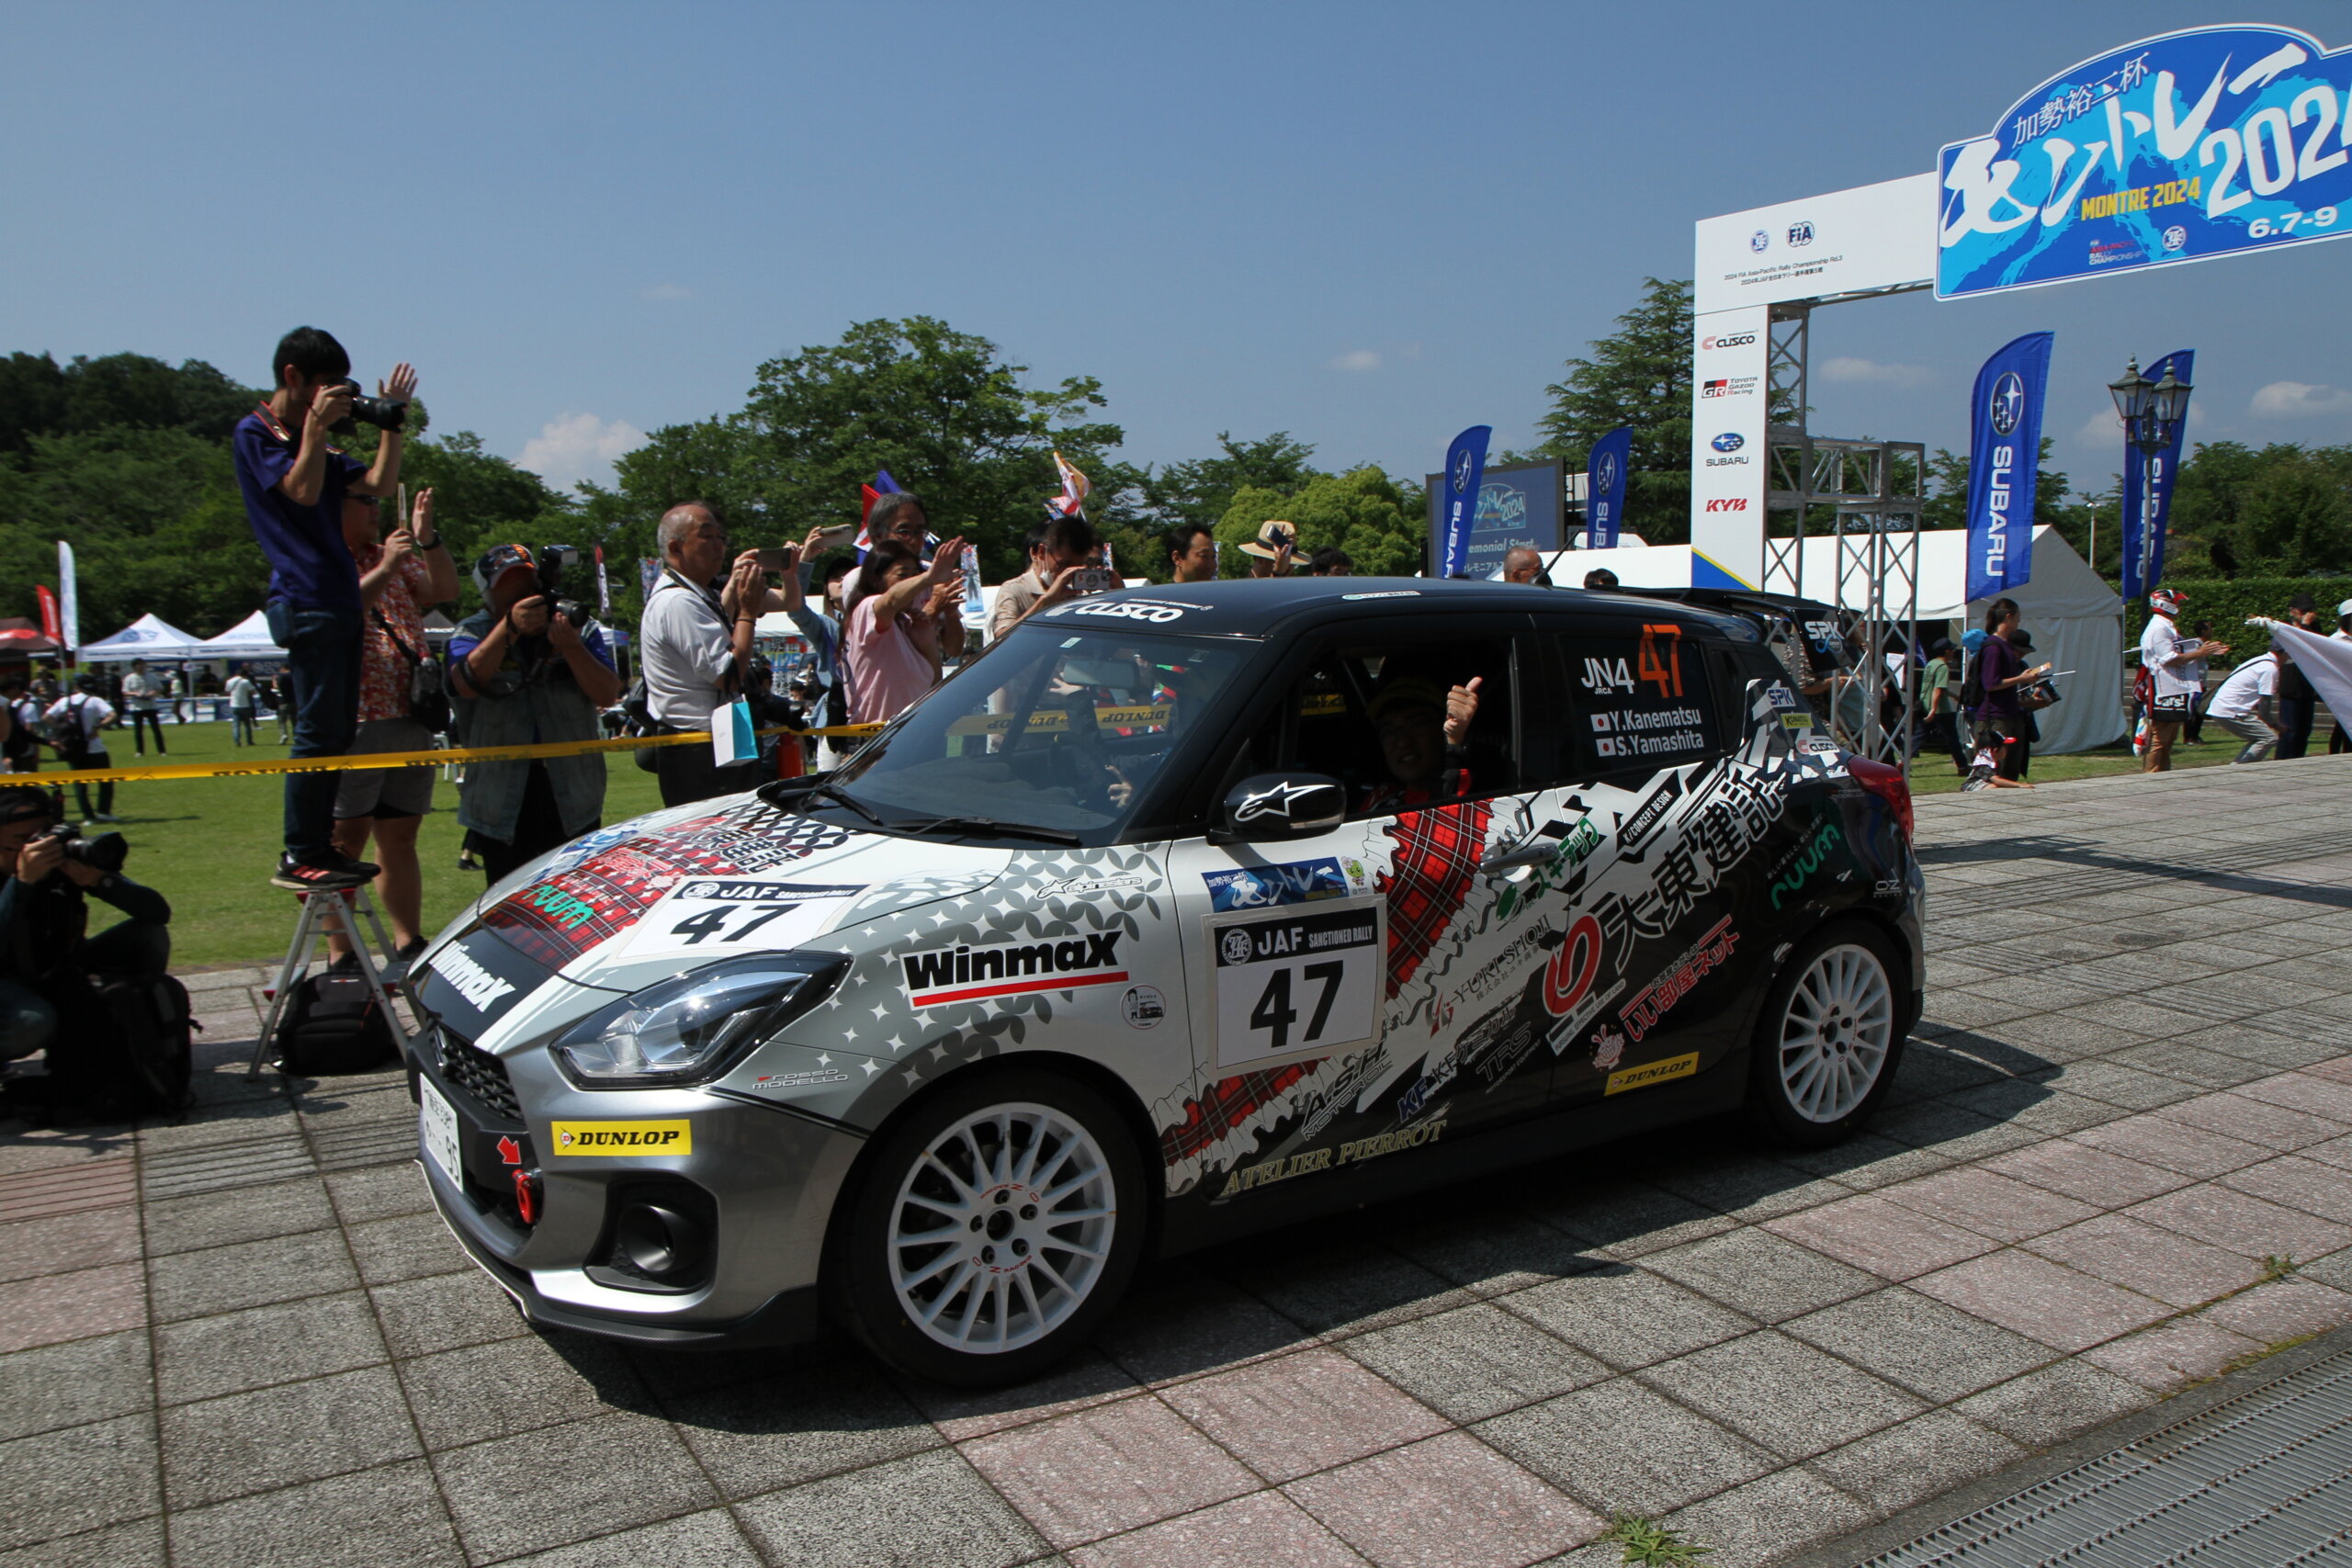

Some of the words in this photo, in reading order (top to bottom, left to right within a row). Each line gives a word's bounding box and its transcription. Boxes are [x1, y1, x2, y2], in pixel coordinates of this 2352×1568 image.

[2080, 186, 2150, 221] MONTRE
[2152, 176, 2201, 209] 2024
[2248, 206, 2339, 239] 6.7-9
[1716, 335, 1756, 348] CUSCO
[1702, 387, 1725, 398] GR
[1706, 457, 1749, 467] SUBARU
[1705, 498, 1747, 512] KYB
[1986, 446, 2012, 578] SUBARU
[1075, 602, 1183, 623] CUSCO
[1804, 621, 1845, 640] SPK
[1637, 624, 1684, 698] 47
[1580, 658, 1635, 694] JN4
[1594, 687, 1613, 695] JRCA
[1768, 689, 1793, 706] SPK
[1609, 705, 1702, 732] Y.Kanematsu
[1615, 729, 1705, 757] S.Yamashita
[1654, 788, 1674, 813] DESIGN
[1068, 876, 1143, 893] alpinestars
[1603, 768, 1785, 976] 大東建託
[1874, 879, 1901, 891] OZ
[719, 886, 779, 898] JAF
[670, 903, 803, 945] 47
[1258, 927, 1304, 955] JAF
[1308, 929, 1352, 949] SANCTIONED
[1352, 926, 1373, 942] RALLY
[1454, 958, 1501, 1004] YUKI
[1503, 913, 1551, 965] SHOJI
[1623, 931, 1740, 1043] いい部屋ネット
[1250, 960, 1344, 1048] 47
[1624, 1060, 1691, 1084] DUNLOP
[1304, 1079, 1365, 1142] MOTOR
[1397, 1076, 1429, 1123] KF
[577, 1130, 680, 1146] DUNLOP
[1219, 1147, 1332, 1197] ATELIER
[1337, 1119, 1448, 1168] PIERROT
